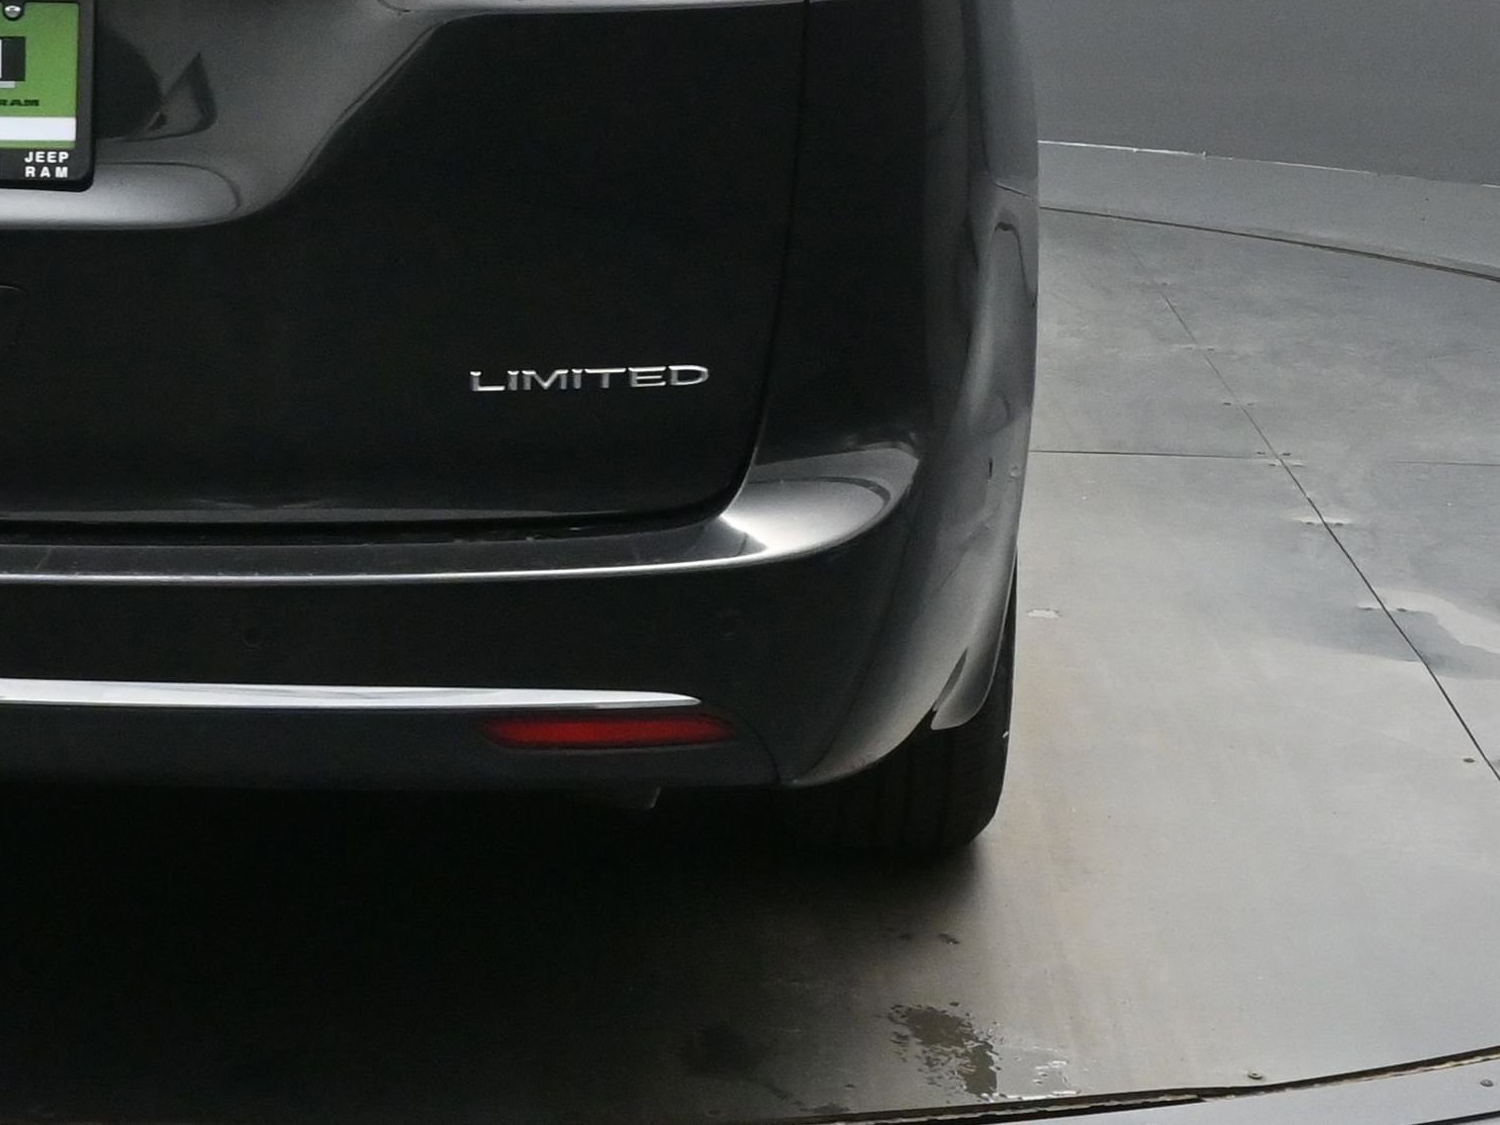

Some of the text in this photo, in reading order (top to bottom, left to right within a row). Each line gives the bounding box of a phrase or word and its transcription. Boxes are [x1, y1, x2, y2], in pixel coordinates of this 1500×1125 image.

[24, 151, 69, 164] JEEP
[25, 166, 68, 179] RAM
[470, 365, 709, 391] LIMITED
